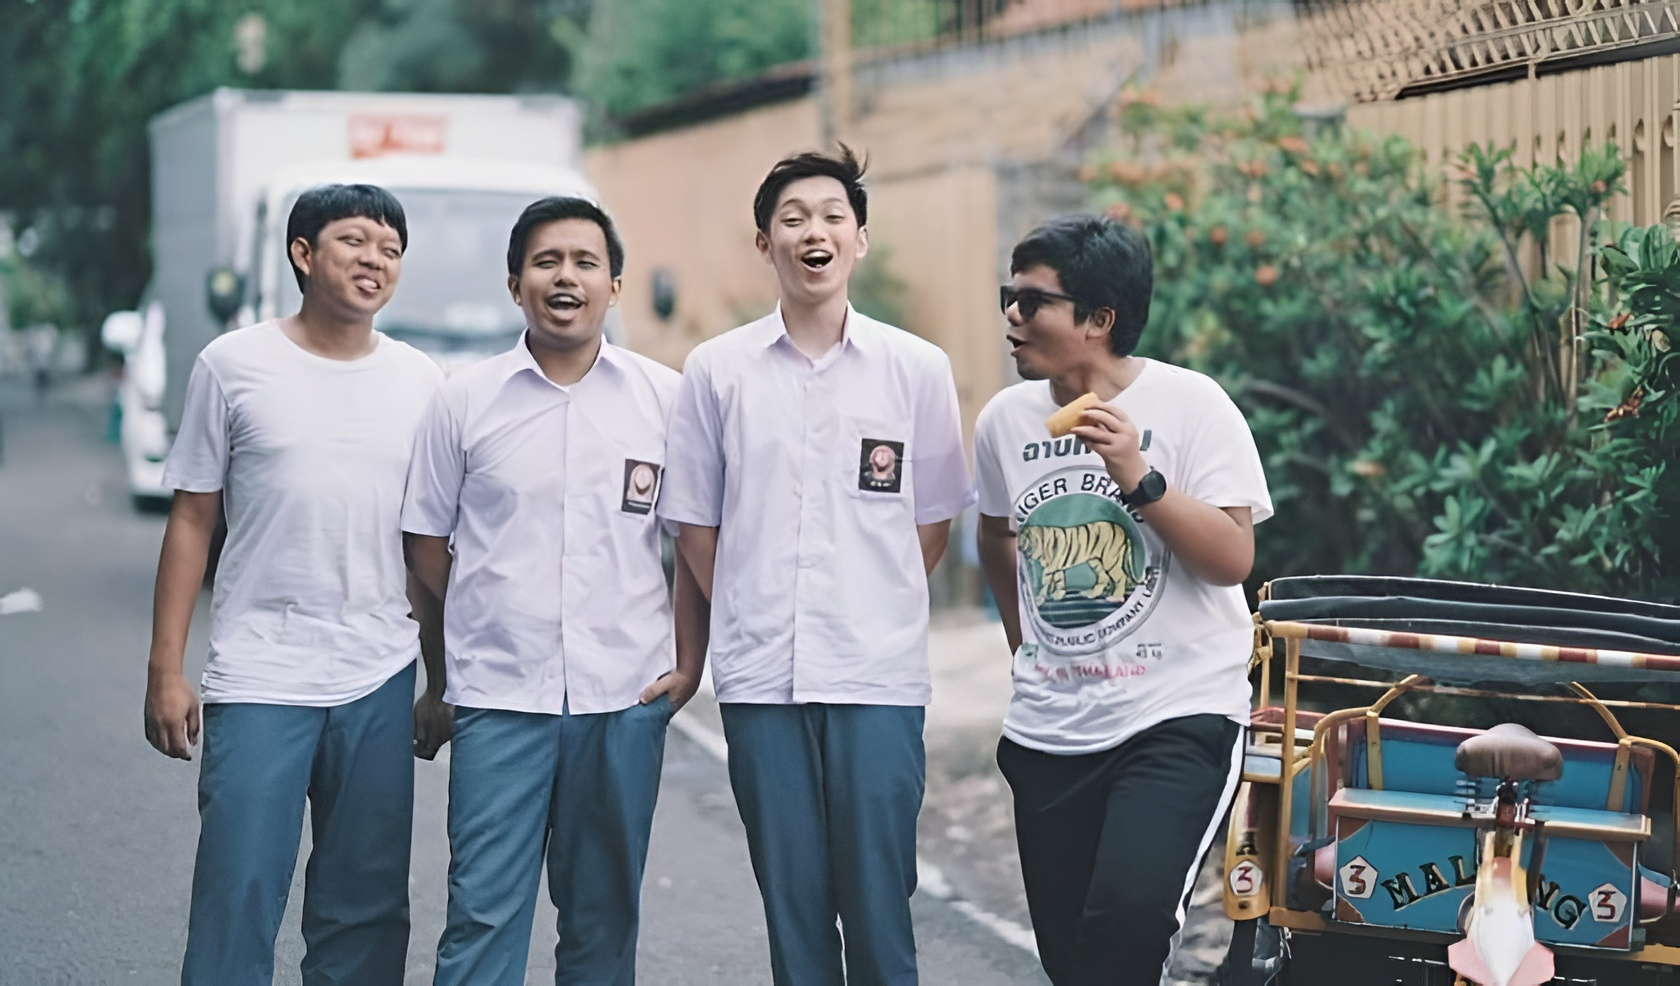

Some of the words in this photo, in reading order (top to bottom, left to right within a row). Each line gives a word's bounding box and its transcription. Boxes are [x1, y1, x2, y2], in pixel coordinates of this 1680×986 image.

[1235, 866, 1254, 894] 3
[1348, 864, 1367, 895] 3
[1380, 854, 1589, 930] MALNG
[1596, 890, 1617, 920] 3
